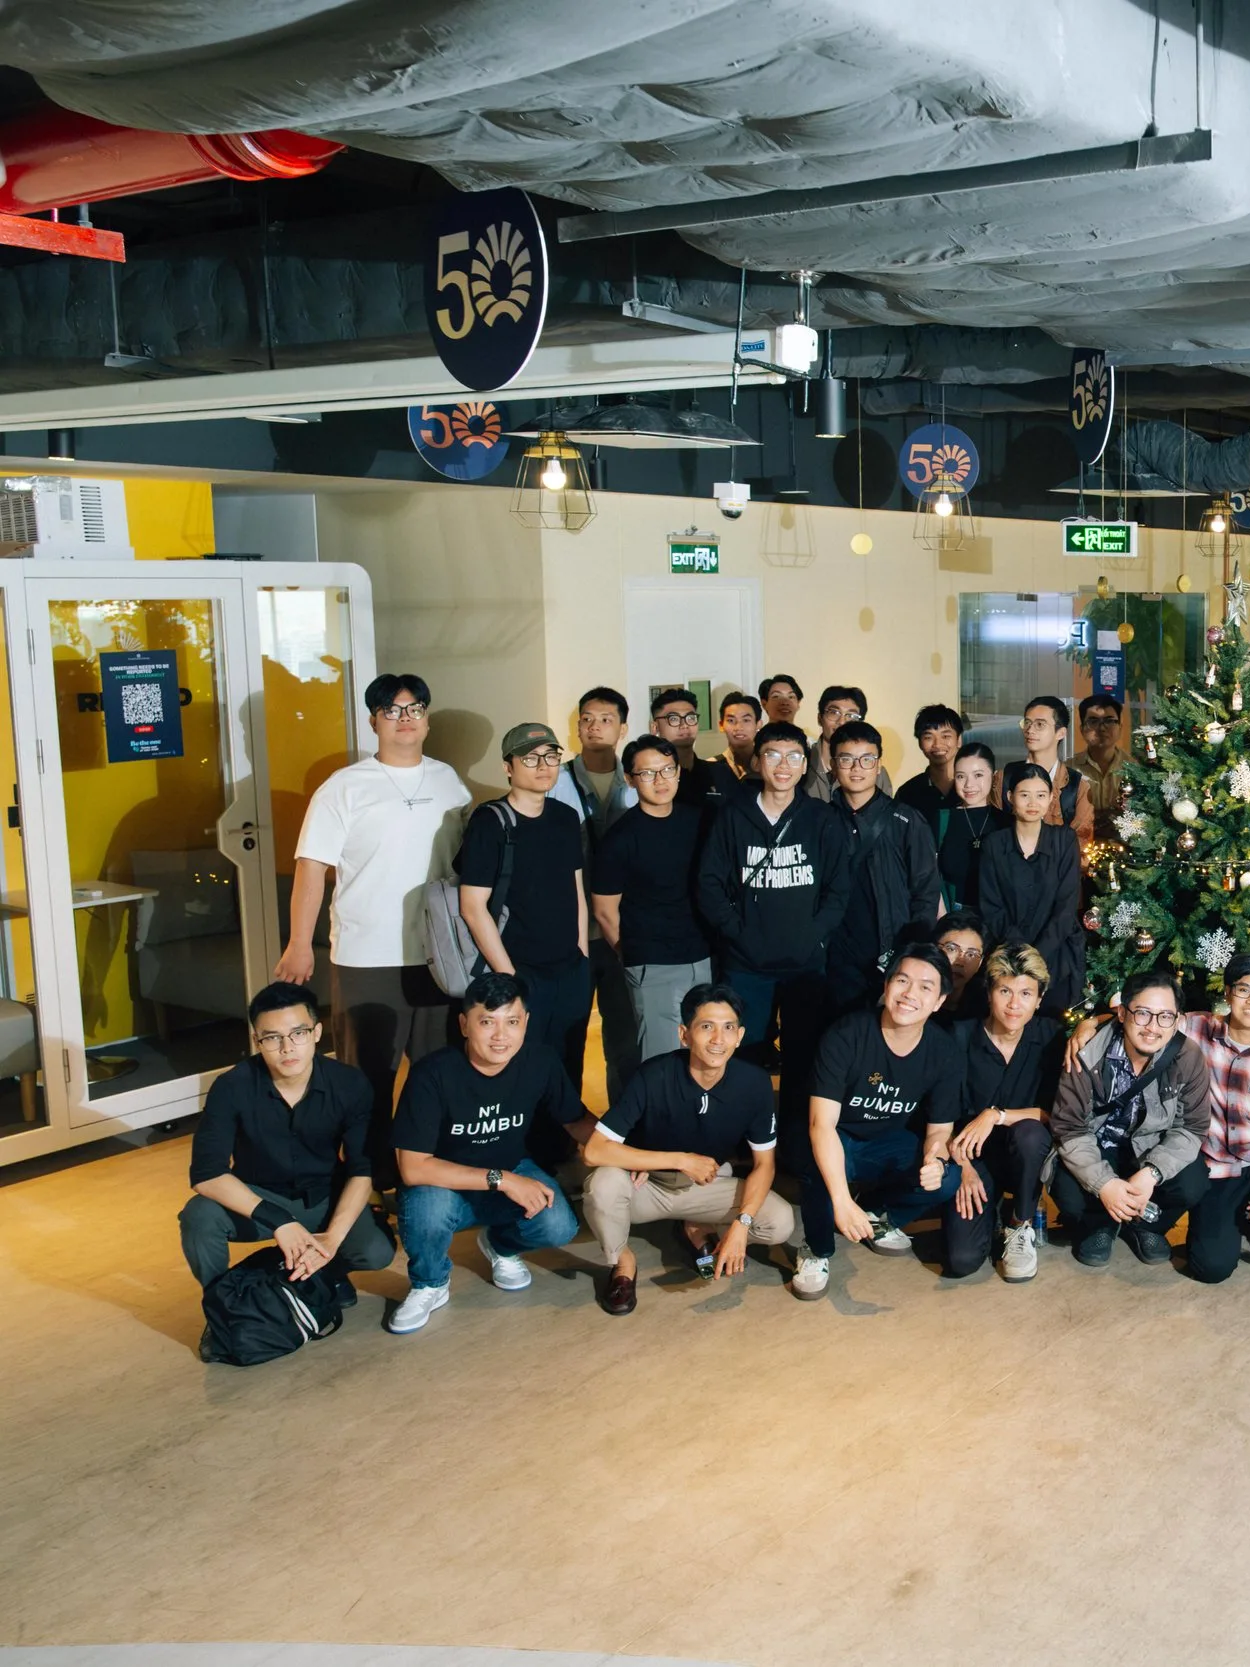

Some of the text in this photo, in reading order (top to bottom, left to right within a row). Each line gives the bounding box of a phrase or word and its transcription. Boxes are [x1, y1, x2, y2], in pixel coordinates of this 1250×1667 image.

[436, 221, 532, 339] 50
[1103, 542, 1123, 550] EXIT
[672, 552, 695, 565] EXIT
[772, 844, 802, 867] MONEY
[765, 865, 814, 888] PROBLEMS
[849, 1096, 917, 1113] BUMBU
[451, 1113, 524, 1135] BUMBU
